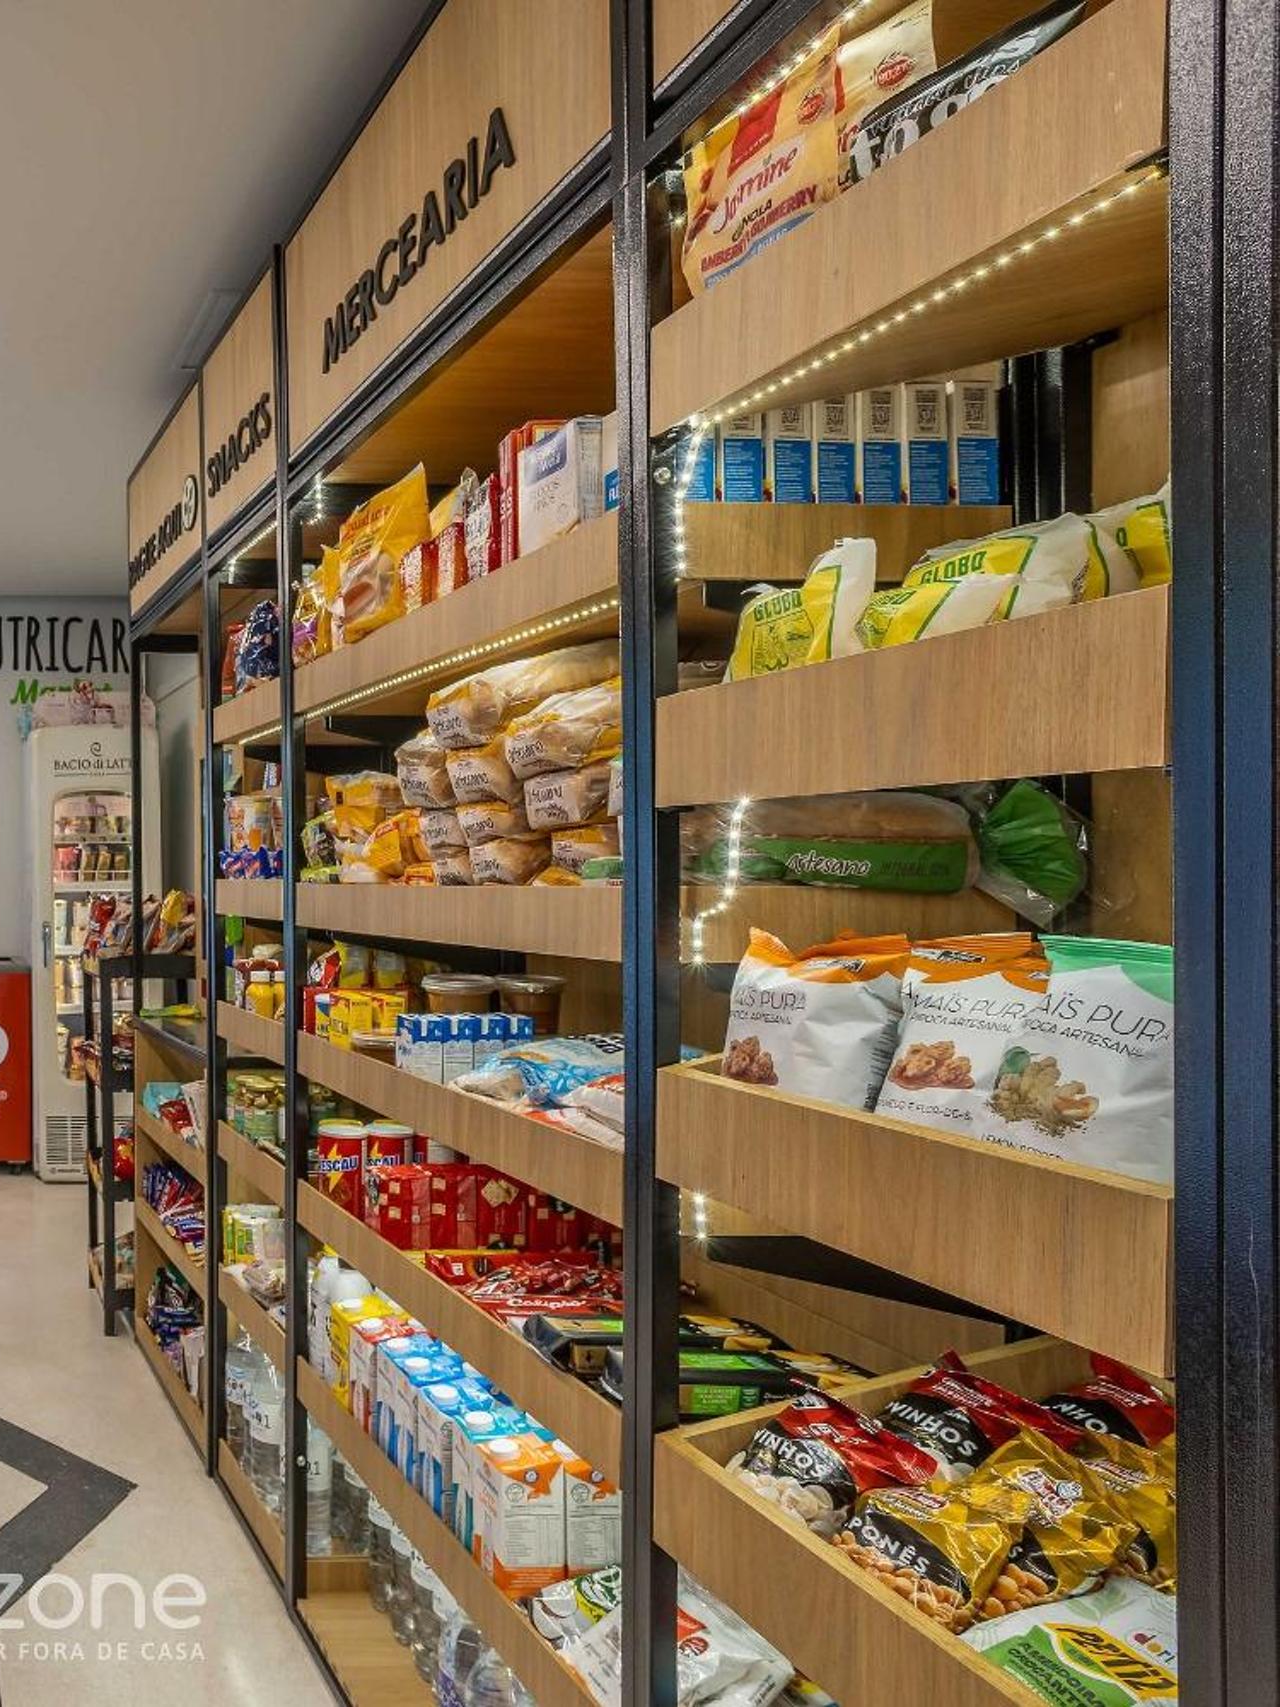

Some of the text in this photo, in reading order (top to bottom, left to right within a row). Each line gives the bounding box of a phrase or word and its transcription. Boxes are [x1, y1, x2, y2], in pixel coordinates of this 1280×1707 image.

[322, 106, 516, 375] MERCEARIA
[206, 391, 272, 498] SNACKS
[920, 550, 988, 585] GLOBO
[753, 590, 803, 623] GLOBO
[54, 759, 91, 771] BACIO
[93, 758, 103, 769] di
[885, 1401, 979, 1457] VINHOS
